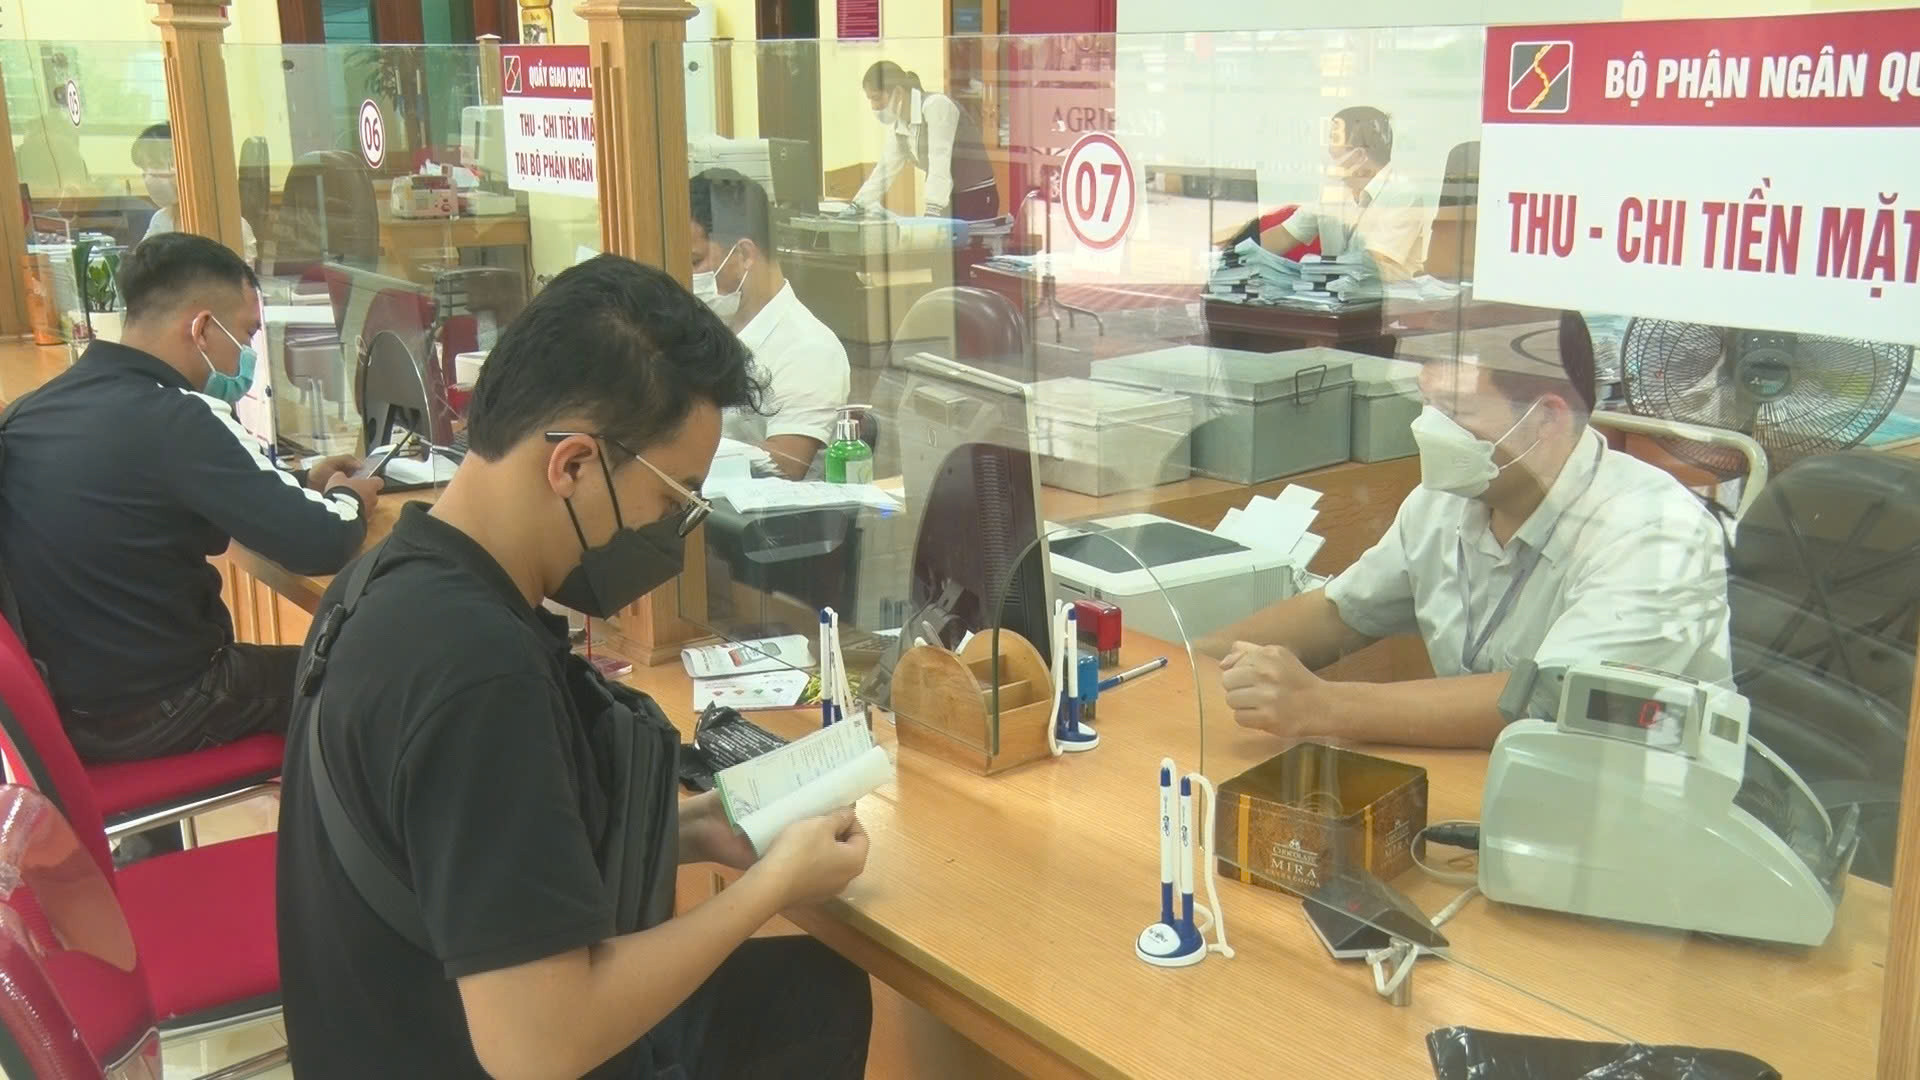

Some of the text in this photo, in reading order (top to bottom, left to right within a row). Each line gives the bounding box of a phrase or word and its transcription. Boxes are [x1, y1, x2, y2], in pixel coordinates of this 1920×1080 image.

[549, 66, 567, 88] GIAO
[567, 66, 586, 92] DỊCH
[1604, 50, 1648, 108] BỘ
[1656, 49, 1750, 108] PHẬN
[1759, 45, 1869, 98] NGÂN
[364, 116, 381, 152] 06
[519, 113, 536, 137] THU
[543, 114, 558, 139] CHI
[515, 148, 594, 184] TẠI BỘ PHẬN NGÂN
[1075, 160, 1122, 223] 07
[1508, 191, 1577, 258] THU
[1616, 196, 1687, 266] CHI
[1701, 177, 1803, 276] TIỀN
[1815, 191, 1920, 298] MẶT
[1271, 858, 1318, 879] MIRA
